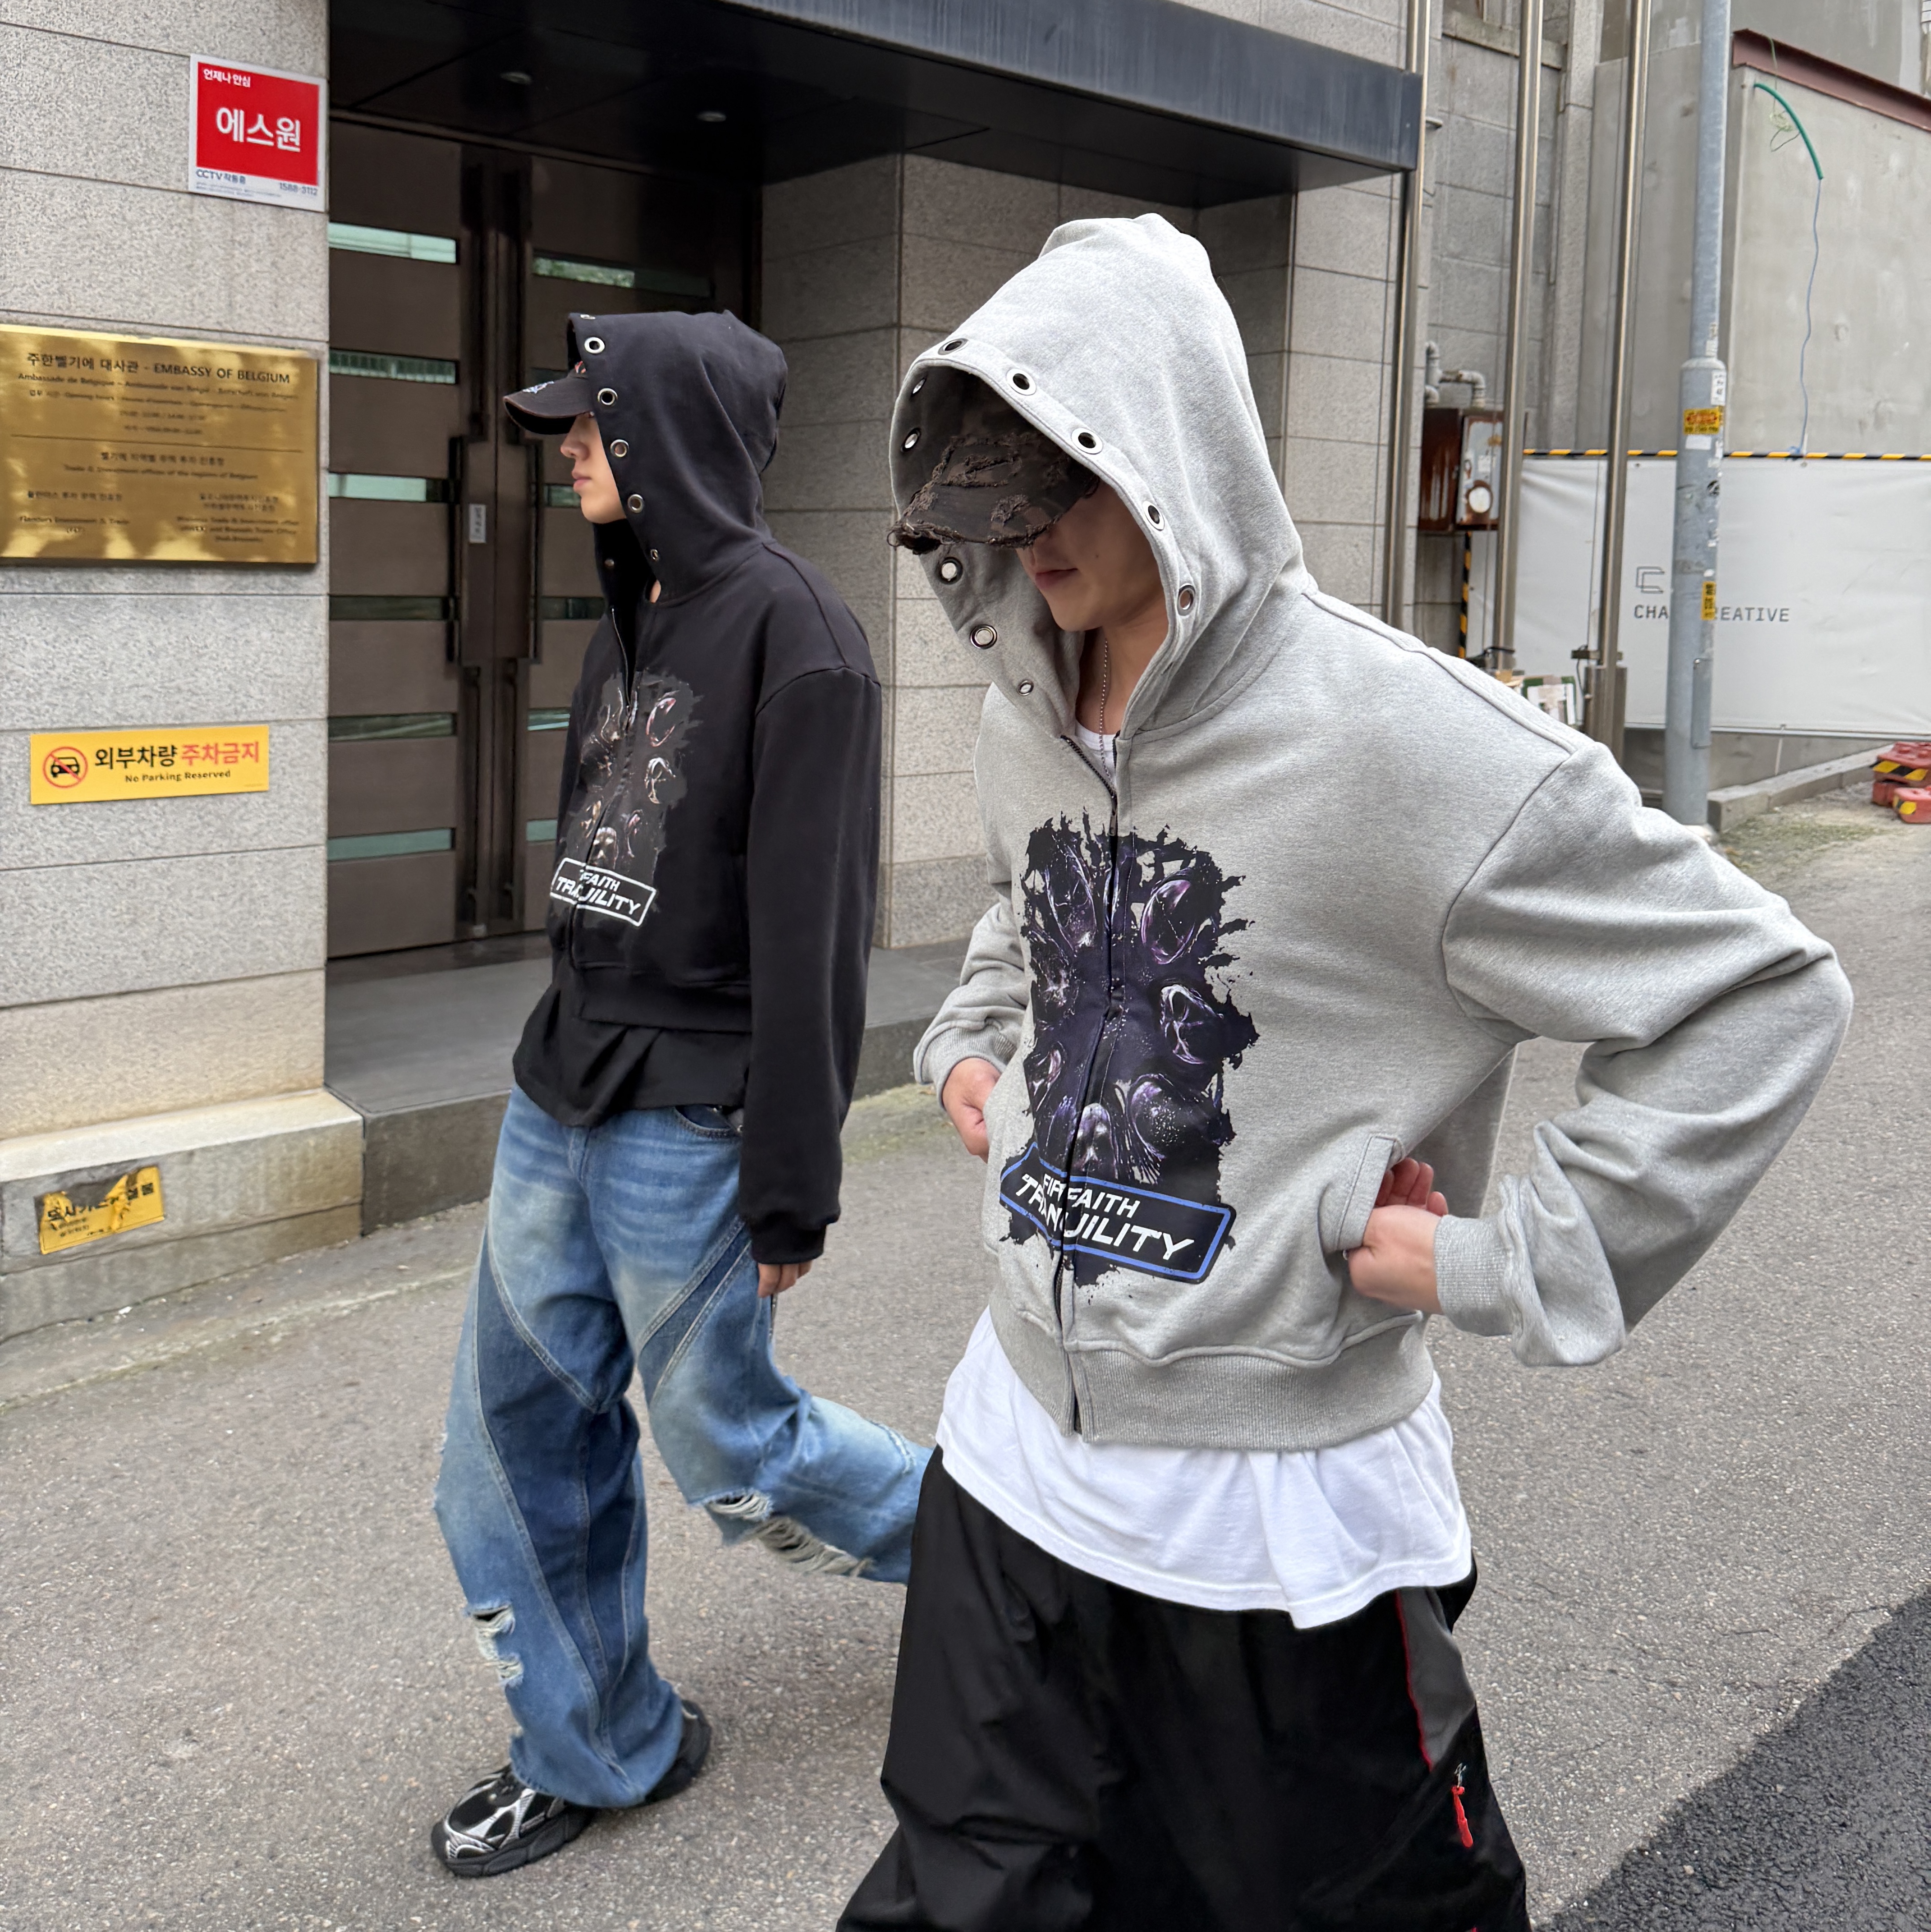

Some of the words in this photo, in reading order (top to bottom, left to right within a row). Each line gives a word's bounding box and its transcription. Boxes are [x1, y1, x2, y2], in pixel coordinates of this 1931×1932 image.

[203, 69, 231, 84] 언제나
[216, 107, 300, 152] 에스원
[100, 359, 138, 373] 대사관
[154, 363, 212, 377] EMBASSY
[217, 368, 234, 379] OF
[238, 370, 290, 383] BELGIUM
[1634, 605, 1669, 619] CHA
[95, 745, 178, 770] 외부차량
[181, 741, 260, 766] 주차금지
[125, 775, 138, 783] No
[142, 772, 182, 782] Parking
[184, 769, 231, 780] Reserved
